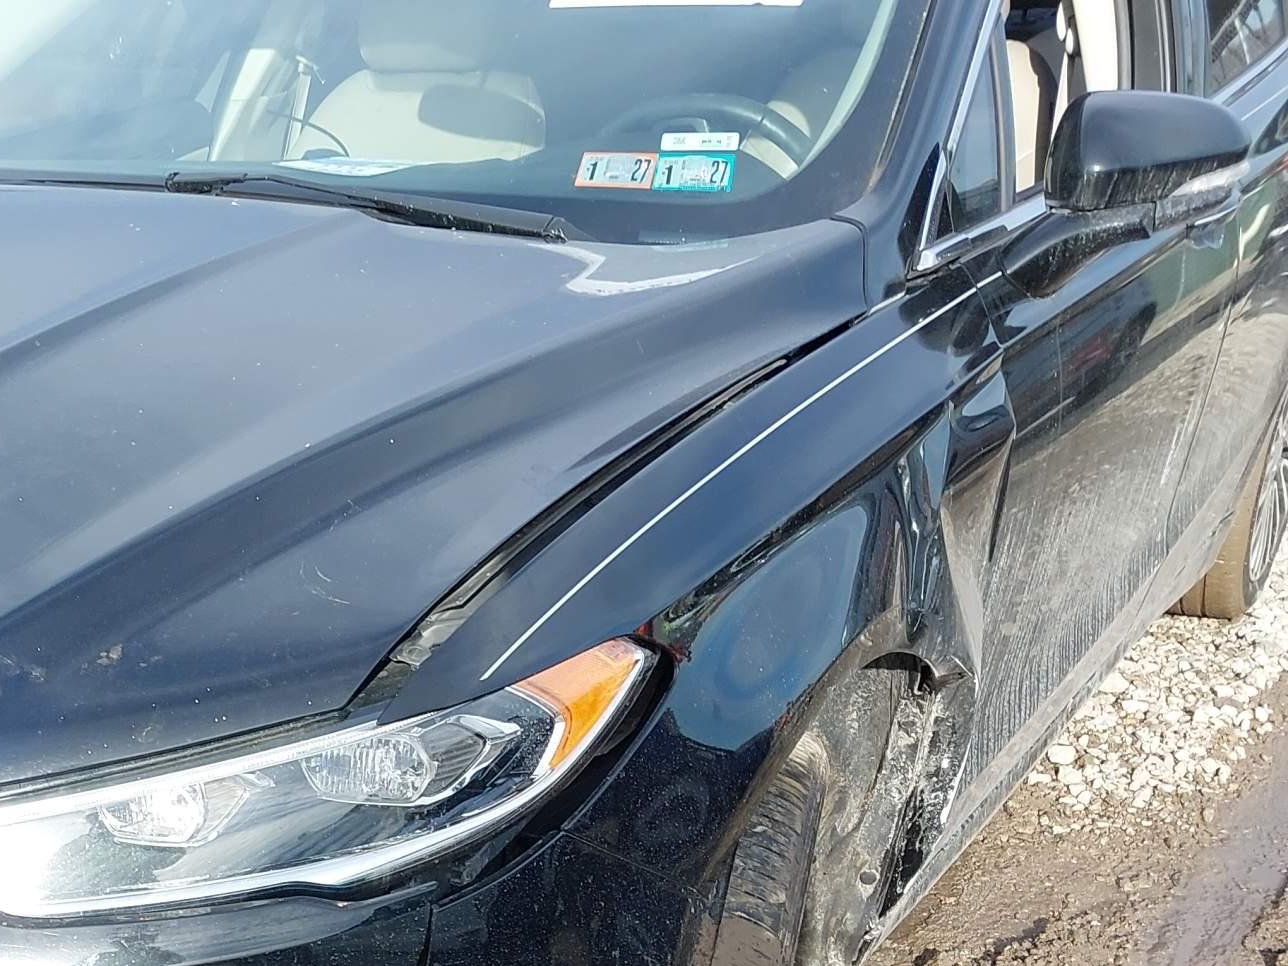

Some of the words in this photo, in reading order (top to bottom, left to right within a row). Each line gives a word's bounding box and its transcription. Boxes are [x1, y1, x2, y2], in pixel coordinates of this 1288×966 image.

[589, 161, 599, 181] 1
[630, 158, 652, 184] 27
[664, 164, 674, 185] 1
[710, 160, 728, 184] 27
